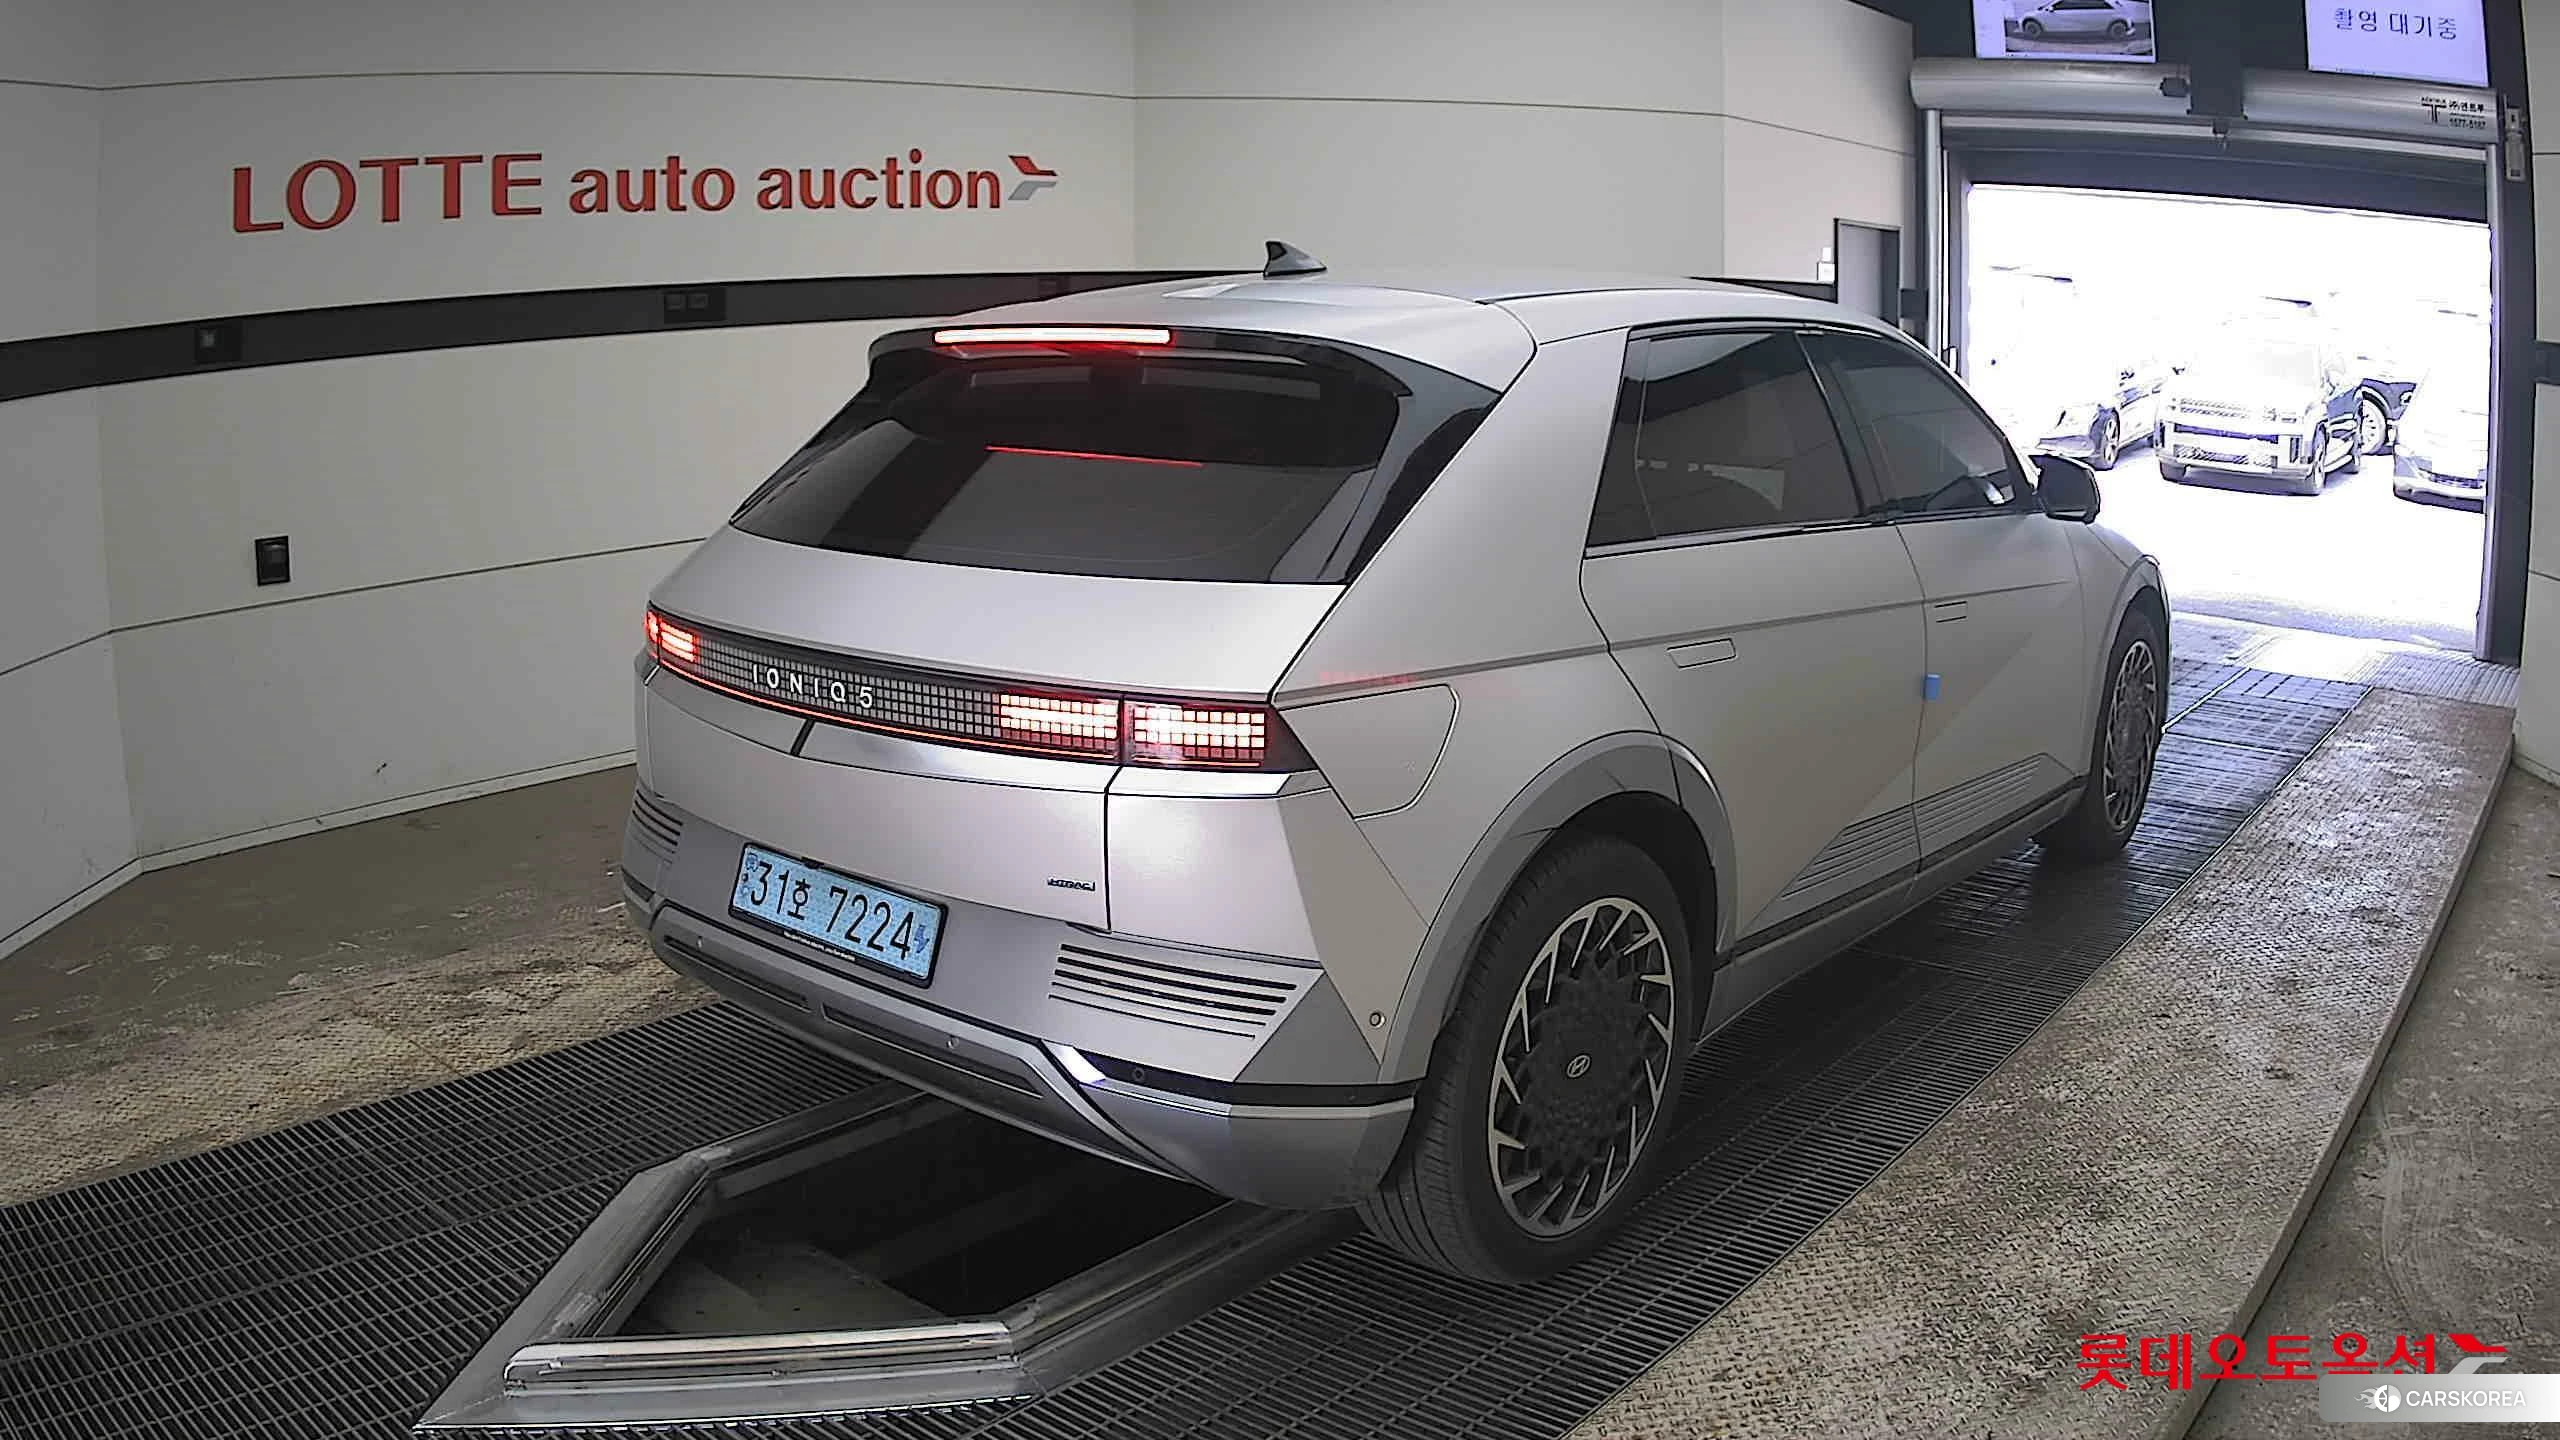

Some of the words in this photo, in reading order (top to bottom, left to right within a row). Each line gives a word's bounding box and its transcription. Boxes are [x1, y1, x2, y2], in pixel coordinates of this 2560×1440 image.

[2389, 12, 2457, 41] 대기중
[232, 153, 542, 233] LOTTE
[568, 154, 736, 213] auto
[756, 147, 1001, 211] auction
[753, 663, 847, 703] IONIQ
[859, 685, 874, 709] 5
[749, 860, 811, 921] 31호
[825, 885, 915, 961] 7224
